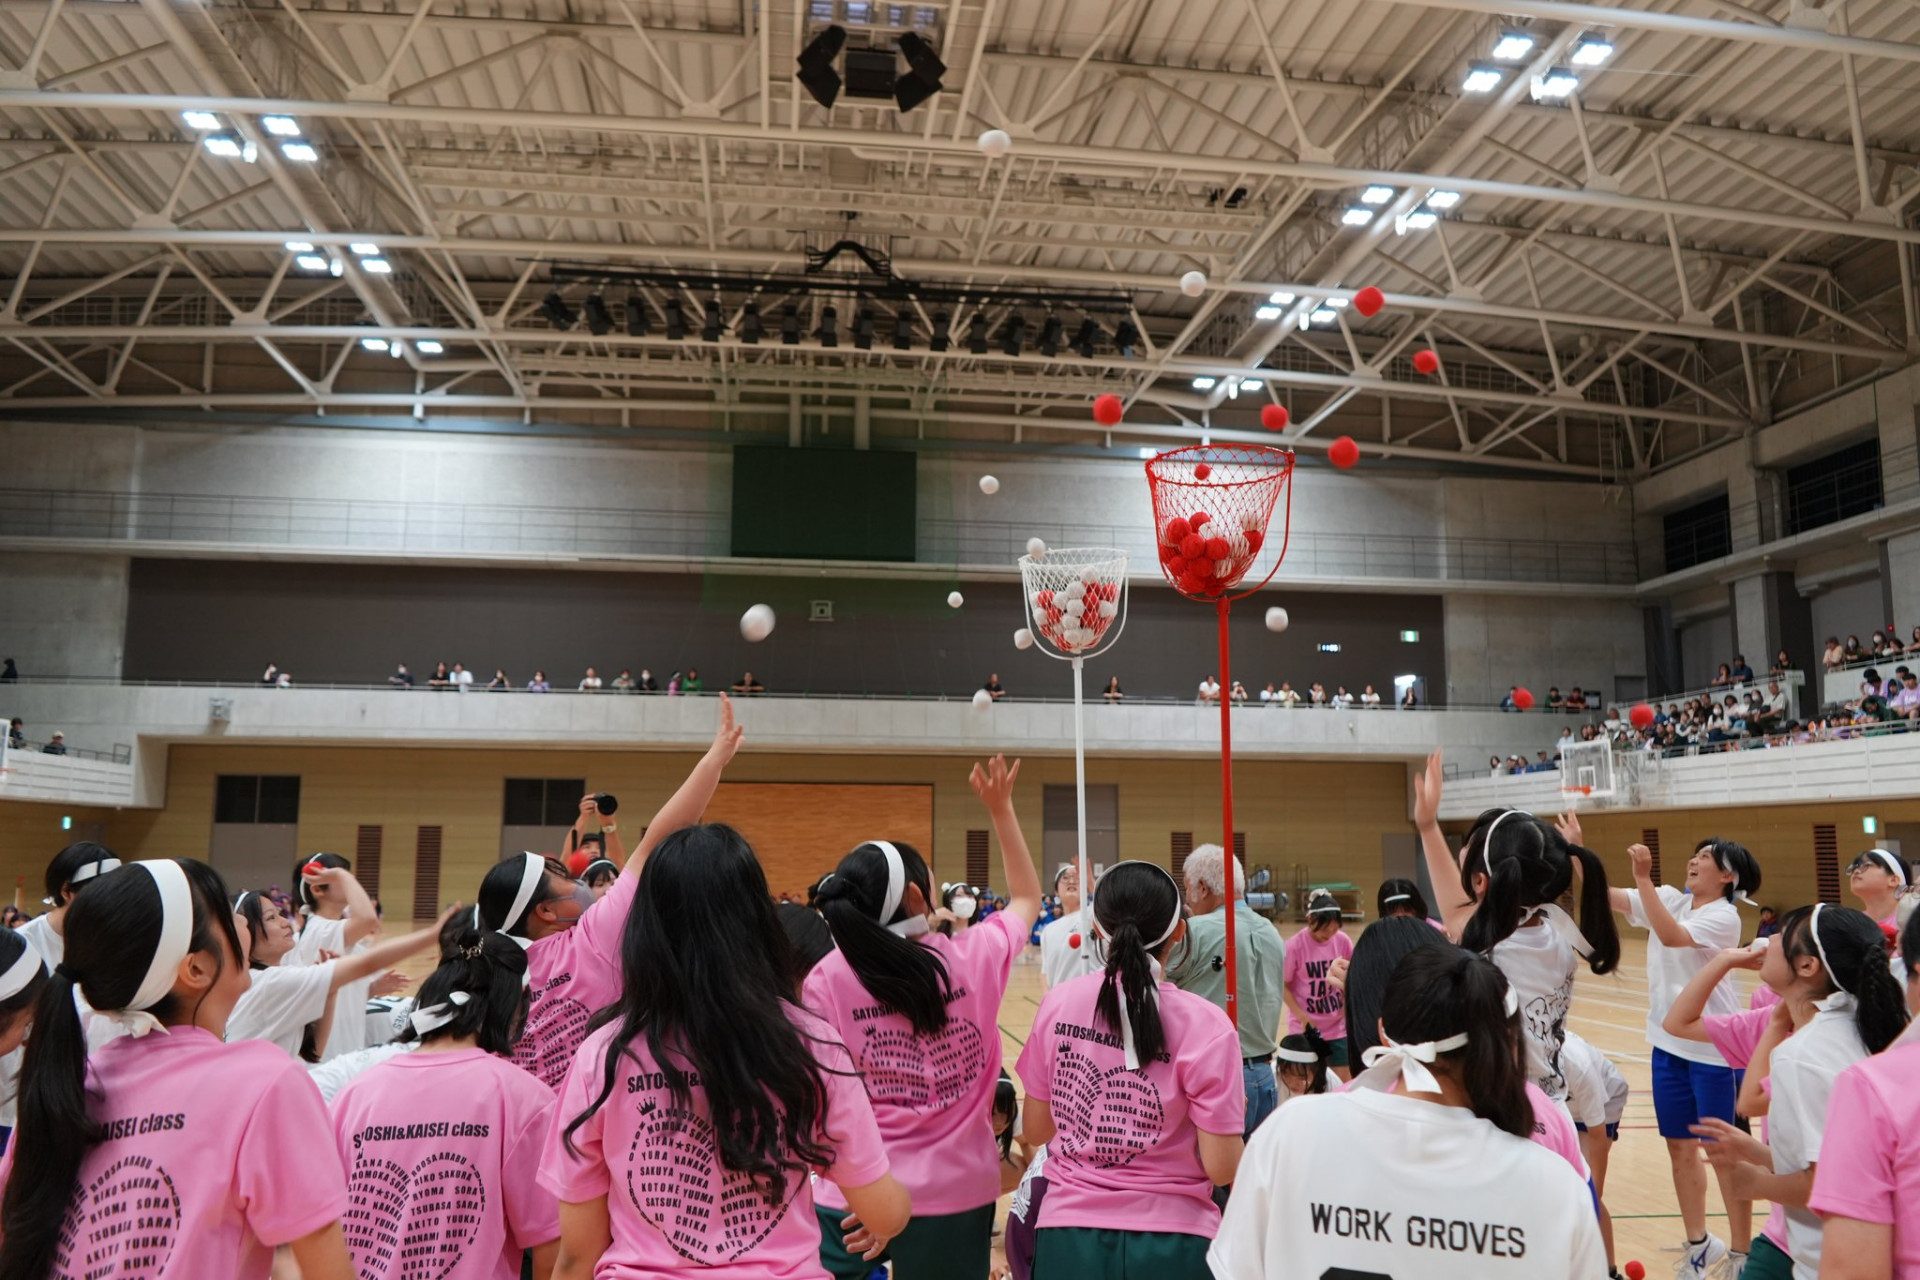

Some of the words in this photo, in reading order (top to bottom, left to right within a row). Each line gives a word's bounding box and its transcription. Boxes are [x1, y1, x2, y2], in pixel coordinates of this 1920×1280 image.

[567, 1024, 587, 1037] YUUK
[1054, 1022, 1125, 1051] SATOSHI&KAIS
[1064, 1052, 1085, 1062] KANA
[1085, 1057, 1104, 1082] SUZUNE
[1085, 1070, 1103, 1096] SOUYA
[1107, 1080, 1126, 1088] RIKO
[1127, 1082, 1152, 1096] SAKURA
[1105, 1092, 1132, 1101] RYOMA
[1075, 1101, 1092, 1120] YUUKA
[1103, 1104, 1137, 1116] TSUBASA
[1139, 1110, 1158, 1122] SARA
[140, 1112, 185, 1135] class
[649, 1108, 678, 1122] KANA
[682, 1110, 714, 1136] SUZUNE
[1058, 1122, 1067, 1131] AO
[1076, 1112, 1093, 1132] YUUMA
[1100, 1115, 1126, 1125] AKITO
[353, 1122, 450, 1149] SOSHI&KAISEI
[451, 1121, 490, 1138] class
[647, 1121, 688, 1134] MOMOKA
[689, 1128, 716, 1154] SOUYA
[1096, 1126, 1126, 1136] MANAMI
[1094, 1136, 1123, 1147] KONOMI
[1127, 1140, 1144, 1150] MAO
[439, 1152, 467, 1165] ARABU
[641, 1151, 668, 1162] YURA
[674, 1155, 712, 1177] NANAKO
[351, 1170, 390, 1182] MOMOKA
[356, 1158, 383, 1169] KANA
[385, 1160, 411, 1186] SUZUNE
[414, 1173, 436, 1187] RIKO
[438, 1170, 472, 1181] SAKURA
[640, 1166, 674, 1177] SAKUYA
[678, 1172, 709, 1190] YUUKA
[722, 1171, 749, 1187] AKIT
[93, 1185, 117, 1205] RIKO
[120, 1177, 160, 1193] SAKURA
[412, 1186, 445, 1202] RYOMA
[454, 1186, 478, 1196] SORA
[641, 1182, 680, 1195] KOTONE
[683, 1189, 714, 1205] YUUMA
[720, 1184, 758, 1202] MANAMI
[90, 1201, 127, 1225] RYOMA
[136, 1197, 170, 1210] SORA
[411, 1201, 452, 1217] TSUBASA
[456, 1200, 478, 1210] SARA
[645, 1197, 681, 1209] SATSUKI
[686, 1205, 710, 1219] HANA
[720, 1198, 757, 1214] KONOMI
[138, 1216, 172, 1230] SARA
[343, 1209, 371, 1221] KUYA
[407, 1217, 439, 1232] AKITO
[446, 1215, 475, 1224] YUUKA
[654, 1212, 665, 1223] AO
[675, 1215, 707, 1234] CHIKA
[724, 1210, 771, 1228] UDATSU
[342, 1223, 374, 1236] OTONE
[404, 1232, 439, 1246] MANAMI
[446, 1229, 468, 1239] RUKI
[725, 1225, 757, 1239] RENA
[1311, 1202, 1392, 1243] WORK
[1407, 1215, 1526, 1258] GROVES
[125, 1236, 167, 1250] YUUKA
[345, 1238, 374, 1249] TSUKI
[673, 1230, 709, 1254] HINATA
[715, 1239, 744, 1255] MIYU
[401, 1246, 436, 1259] KONOMI
[440, 1244, 459, 1253] MAO
[124, 1254, 156, 1271] RUKI
[403, 1258, 445, 1272] UDATSU
